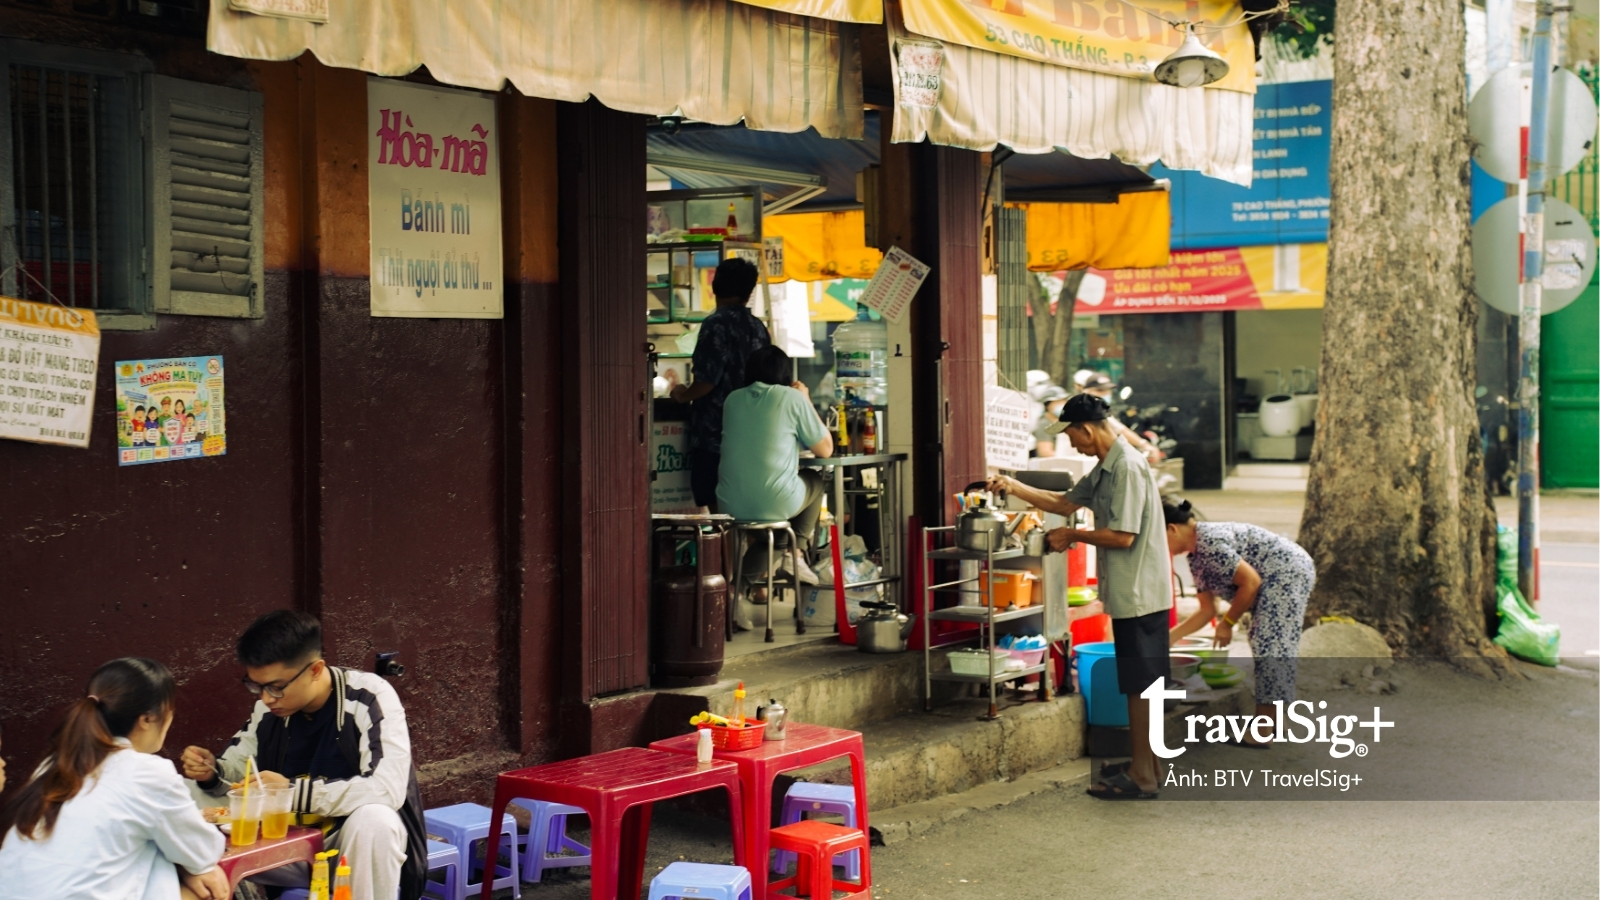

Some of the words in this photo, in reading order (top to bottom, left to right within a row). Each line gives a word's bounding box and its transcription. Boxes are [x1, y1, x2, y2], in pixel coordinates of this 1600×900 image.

[985, 22, 1009, 45] 53
[1011, 29, 1045, 54] CAO
[1050, 35, 1108, 67] THẮNG
[401, 187, 445, 233] Bánh
[451, 193, 470, 235] mì
[1243, 200, 1264, 212] CAO
[1298, 195, 1330, 208] PHƯỜN
[379, 248, 404, 296] Thịt
[407, 250, 440, 298] nguội
[443, 247, 458, 290] đủ
[460, 251, 480, 291] thứ
[1113, 268, 1133, 280] Giá
[1154, 265, 1181, 278] nhất
[1210, 265, 1241, 277] 2025
[0, 300, 84, 328] QUALIT
[4, 328, 39, 343] KHÁCH
[24, 347, 42, 368] VẬT
[44, 352, 70, 371] MANG
[72, 357, 95, 375] THEO
[8, 367, 20, 381] CÓ
[23, 370, 48, 385] NGƯỜI
[51, 373, 78, 389] TRÔNG
[139, 370, 171, 386] KHÔNG
[172, 370, 186, 380] MA
[30, 387, 57, 402] TRÁCH
[59, 392, 86, 407] NHIỆM
[26, 401, 45, 416] MẤT
[47, 404, 65, 419] MÁT
